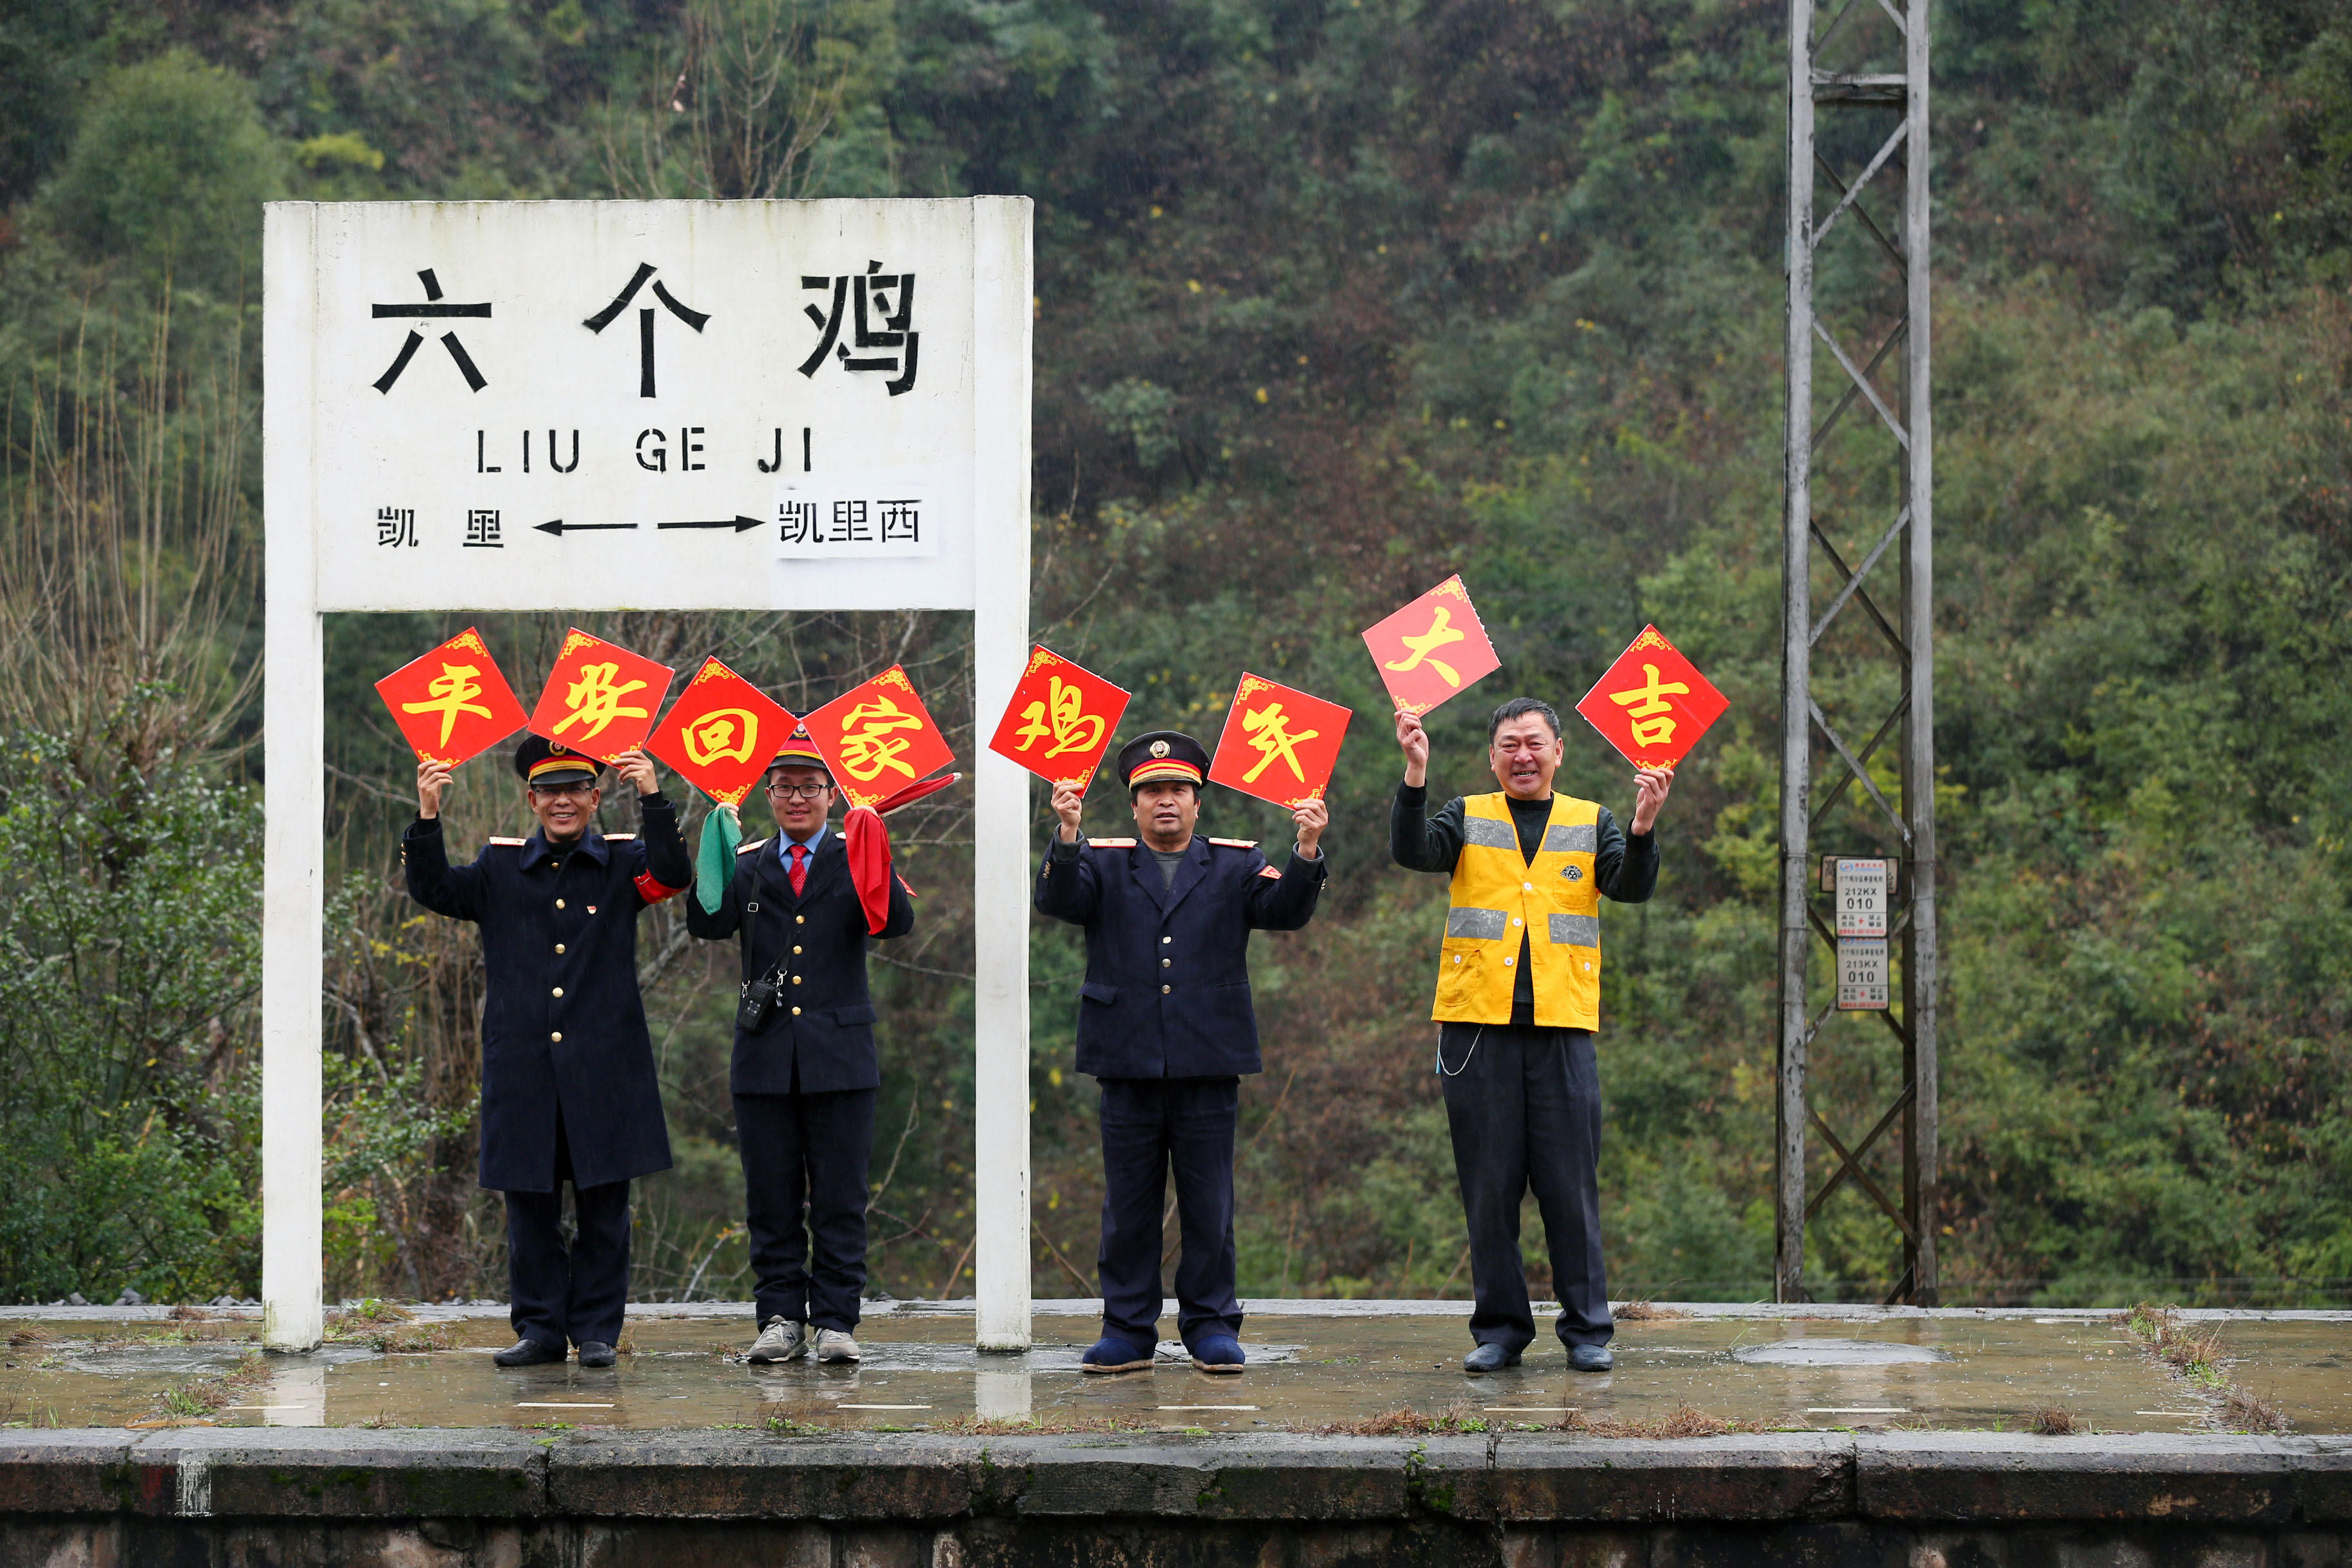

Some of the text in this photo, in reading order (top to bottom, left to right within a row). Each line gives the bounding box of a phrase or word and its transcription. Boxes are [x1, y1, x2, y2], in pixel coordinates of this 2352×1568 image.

[372, 260, 919, 398] 六个鸡
[478, 427, 812, 474] LIU GE JI
[377, 500, 921, 548] 凯里 凯里西
[1384, 606, 1464, 688] 大
[402, 662, 493, 749] 平
[553, 662, 648, 741] 安
[681, 708, 759, 767] 回
[839, 694, 923, 781] 家
[1015, 676, 1105, 758] 鸡
[1609, 663, 1690, 748] 吉
[1242, 702, 1319, 783] 年
[1847, 898, 1873, 909] 010
[1846, 960, 1878, 968] 213KX
[1848, 971, 1875, 983] 010
